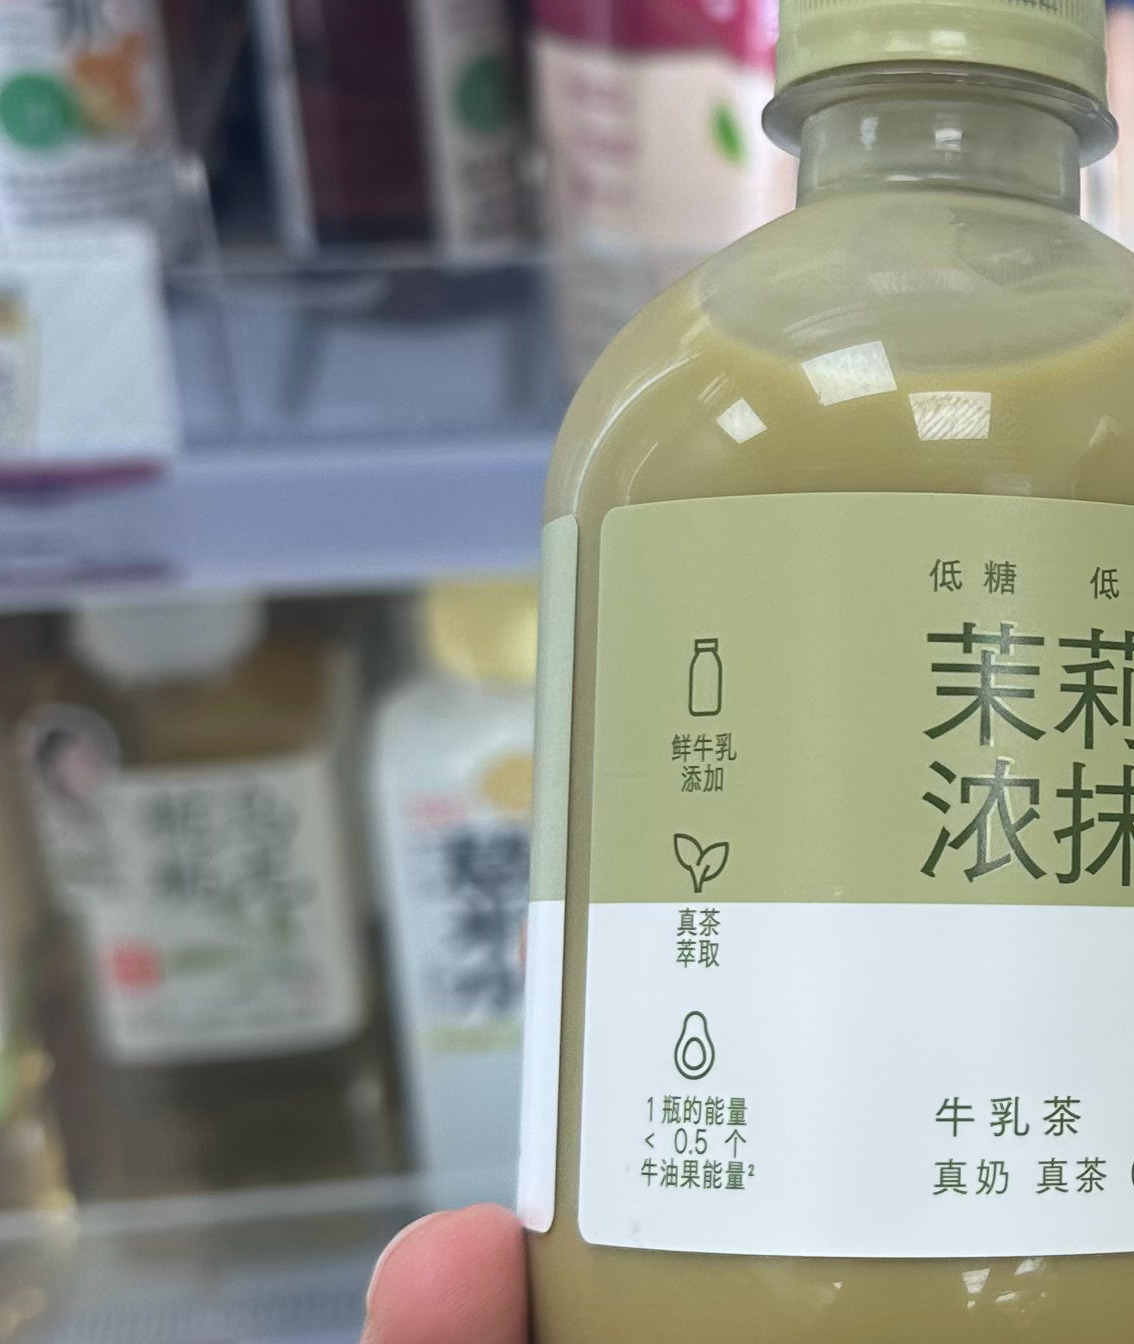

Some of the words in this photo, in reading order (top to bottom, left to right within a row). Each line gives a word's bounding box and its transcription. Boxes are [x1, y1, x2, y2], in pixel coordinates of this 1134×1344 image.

[929, 558, 1018, 595] 低糖
[671, 732, 738, 762] 鲜牛乳
[680, 763, 724, 793] 添加
[676, 908, 721, 937] 真茶
[676, 938, 720, 969] 萃取
[935, 1095, 1082, 1138] 牛乳茶
[932, 1158, 1009, 1196] 真奶
[1036, 1156, 1108, 1194] 真茶
